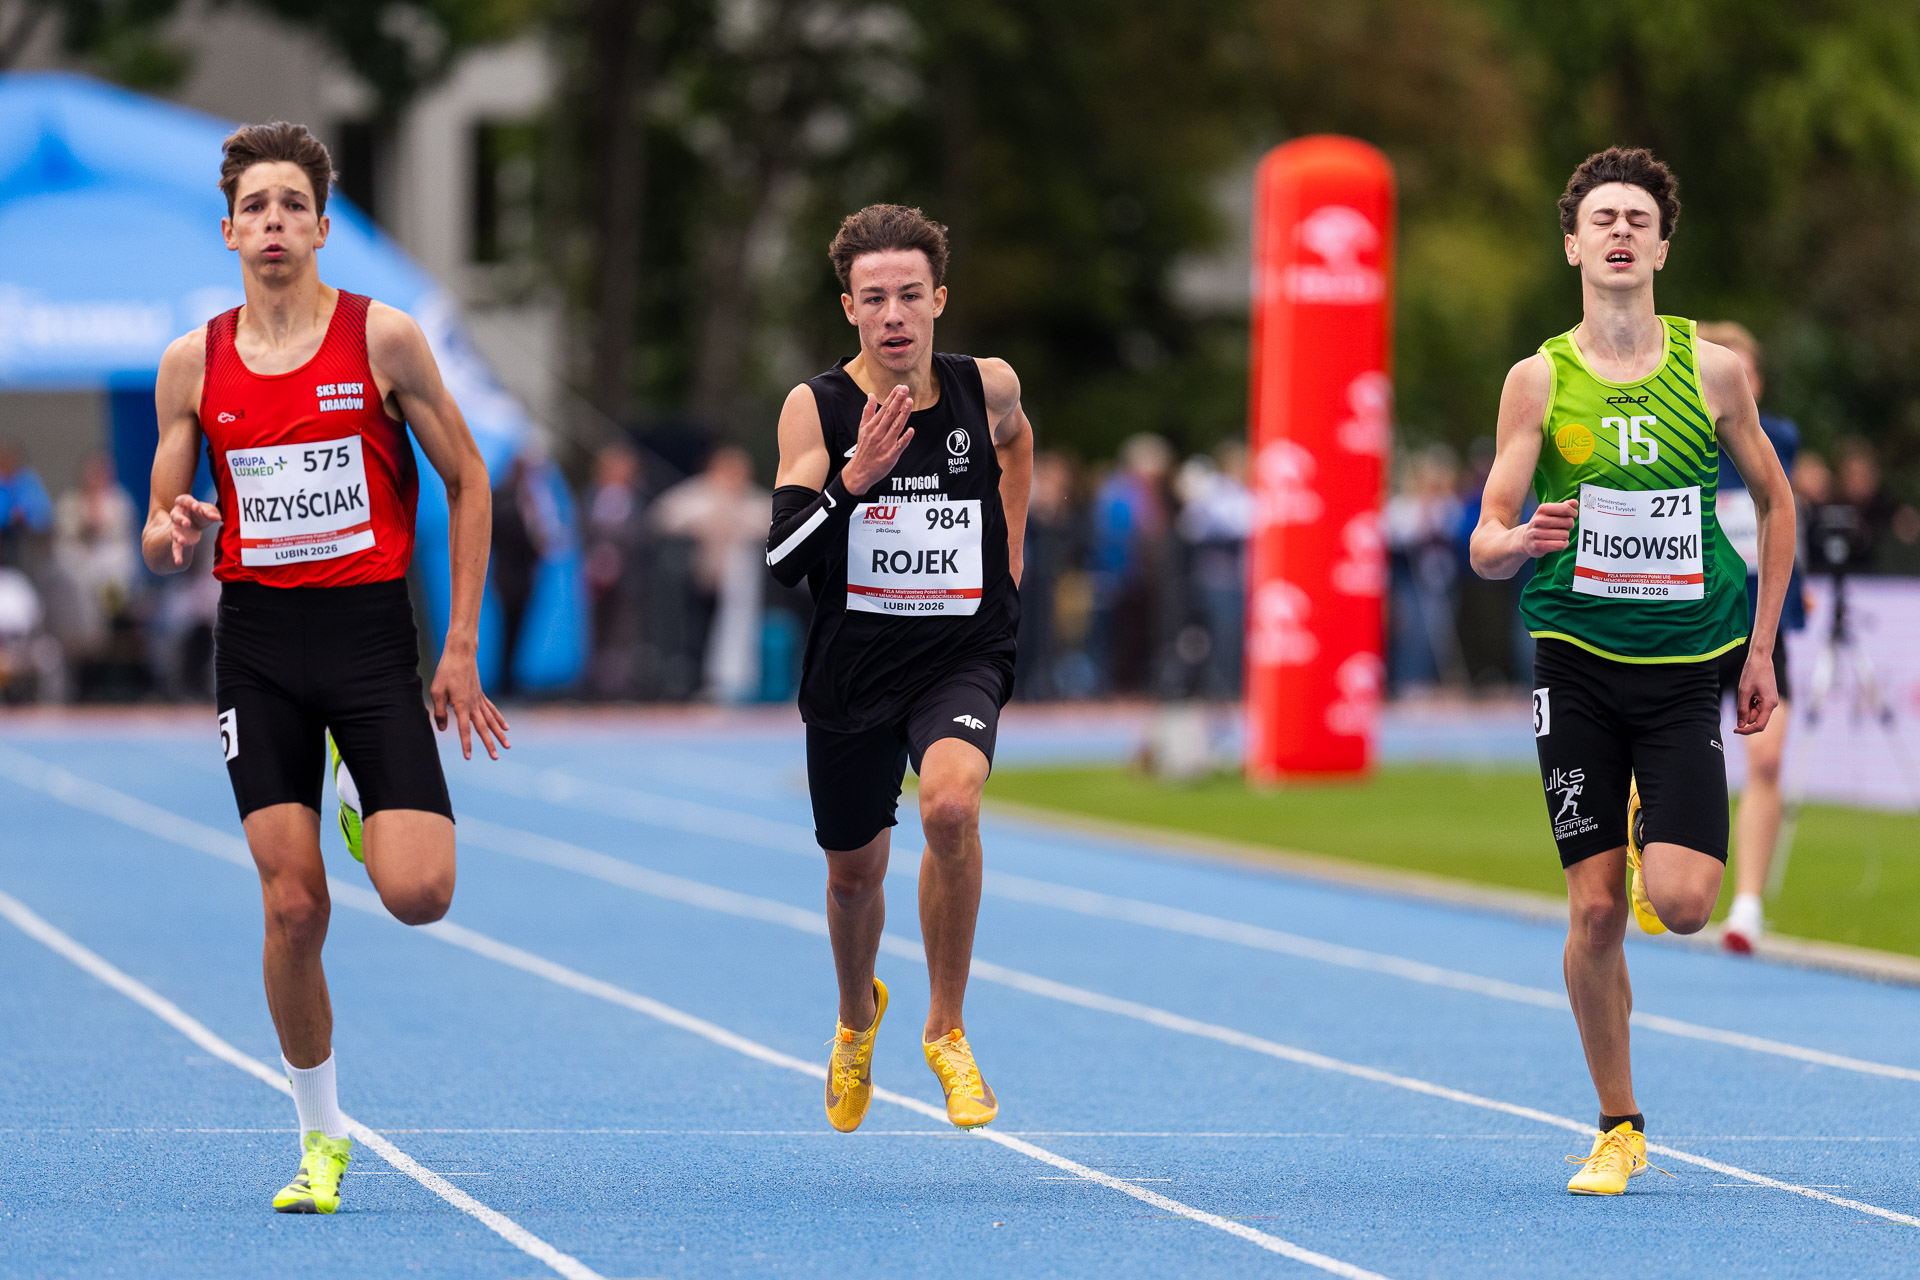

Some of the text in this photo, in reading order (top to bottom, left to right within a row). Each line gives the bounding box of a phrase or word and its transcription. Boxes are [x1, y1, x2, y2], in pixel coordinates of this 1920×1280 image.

[316, 382, 364, 397] SKS KUSY
[319, 396, 364, 412] KRAKÓW
[232, 456, 266, 466] GRUPA
[304, 445, 350, 472] 575
[948, 456, 970, 466] RUDA
[235, 466, 274, 476] LUXMED
[949, 465, 968, 474] Śląska
[892, 473, 939, 491] TL POGOŃ
[243, 483, 364, 522] KRZYŚCIAK
[1650, 494, 1692, 518] 271
[864, 506, 898, 520] RCU
[926, 507, 970, 530] 984
[275, 544, 338, 560] LUBIN 2026
[1582, 530, 1697, 560] FLISOWSKI
[872, 549, 959, 574] ROJEK
[1608, 586, 1668, 595] LUBIN 2026
[883, 602, 944, 610] LUBIN 2026
[953, 714, 986, 729] 4F
[1533, 694, 1543, 733] 3
[1545, 768, 1585, 791] ulks
[1554, 816, 1593, 834] sprinter
[1580, 824, 1598, 833] Góra
